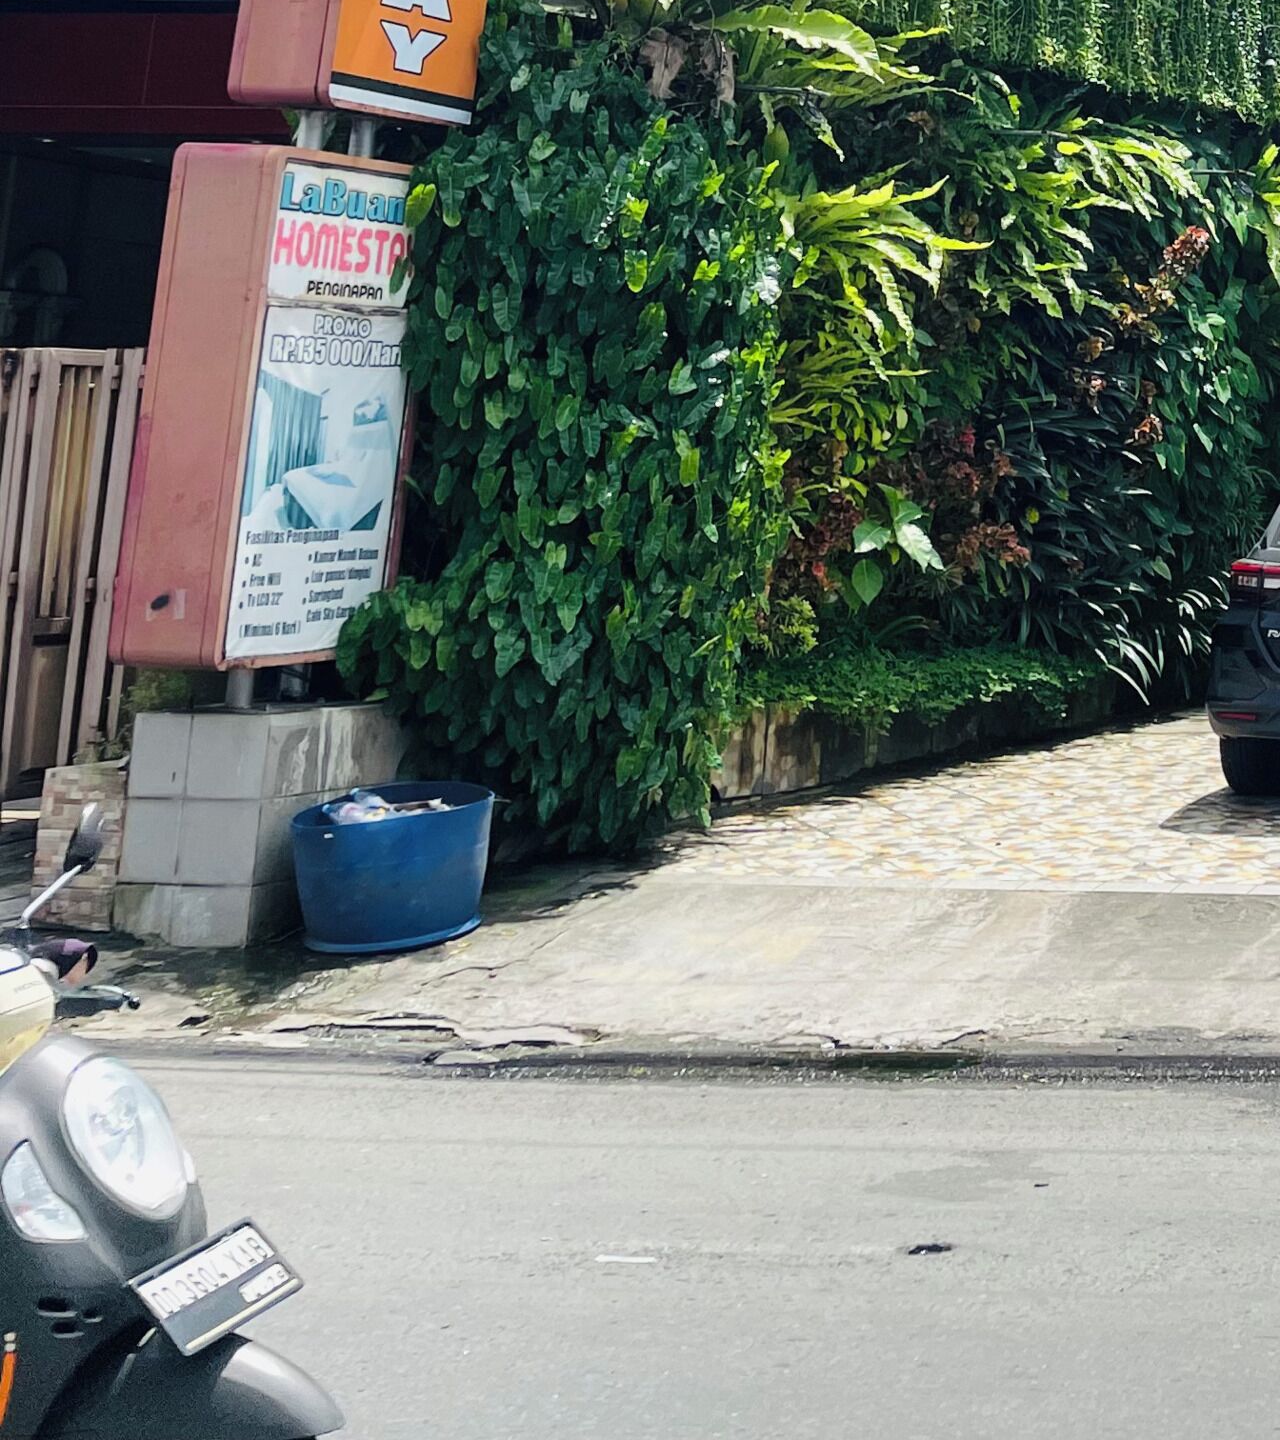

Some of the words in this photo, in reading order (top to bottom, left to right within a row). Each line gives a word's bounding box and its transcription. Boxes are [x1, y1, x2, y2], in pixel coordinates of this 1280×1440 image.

[279, 171, 406, 226] LaBuan
[272, 218, 414, 279] HOMESTA
[307, 280, 383, 300] PENGINAPAN
[313, 314, 372, 338] PROMO
